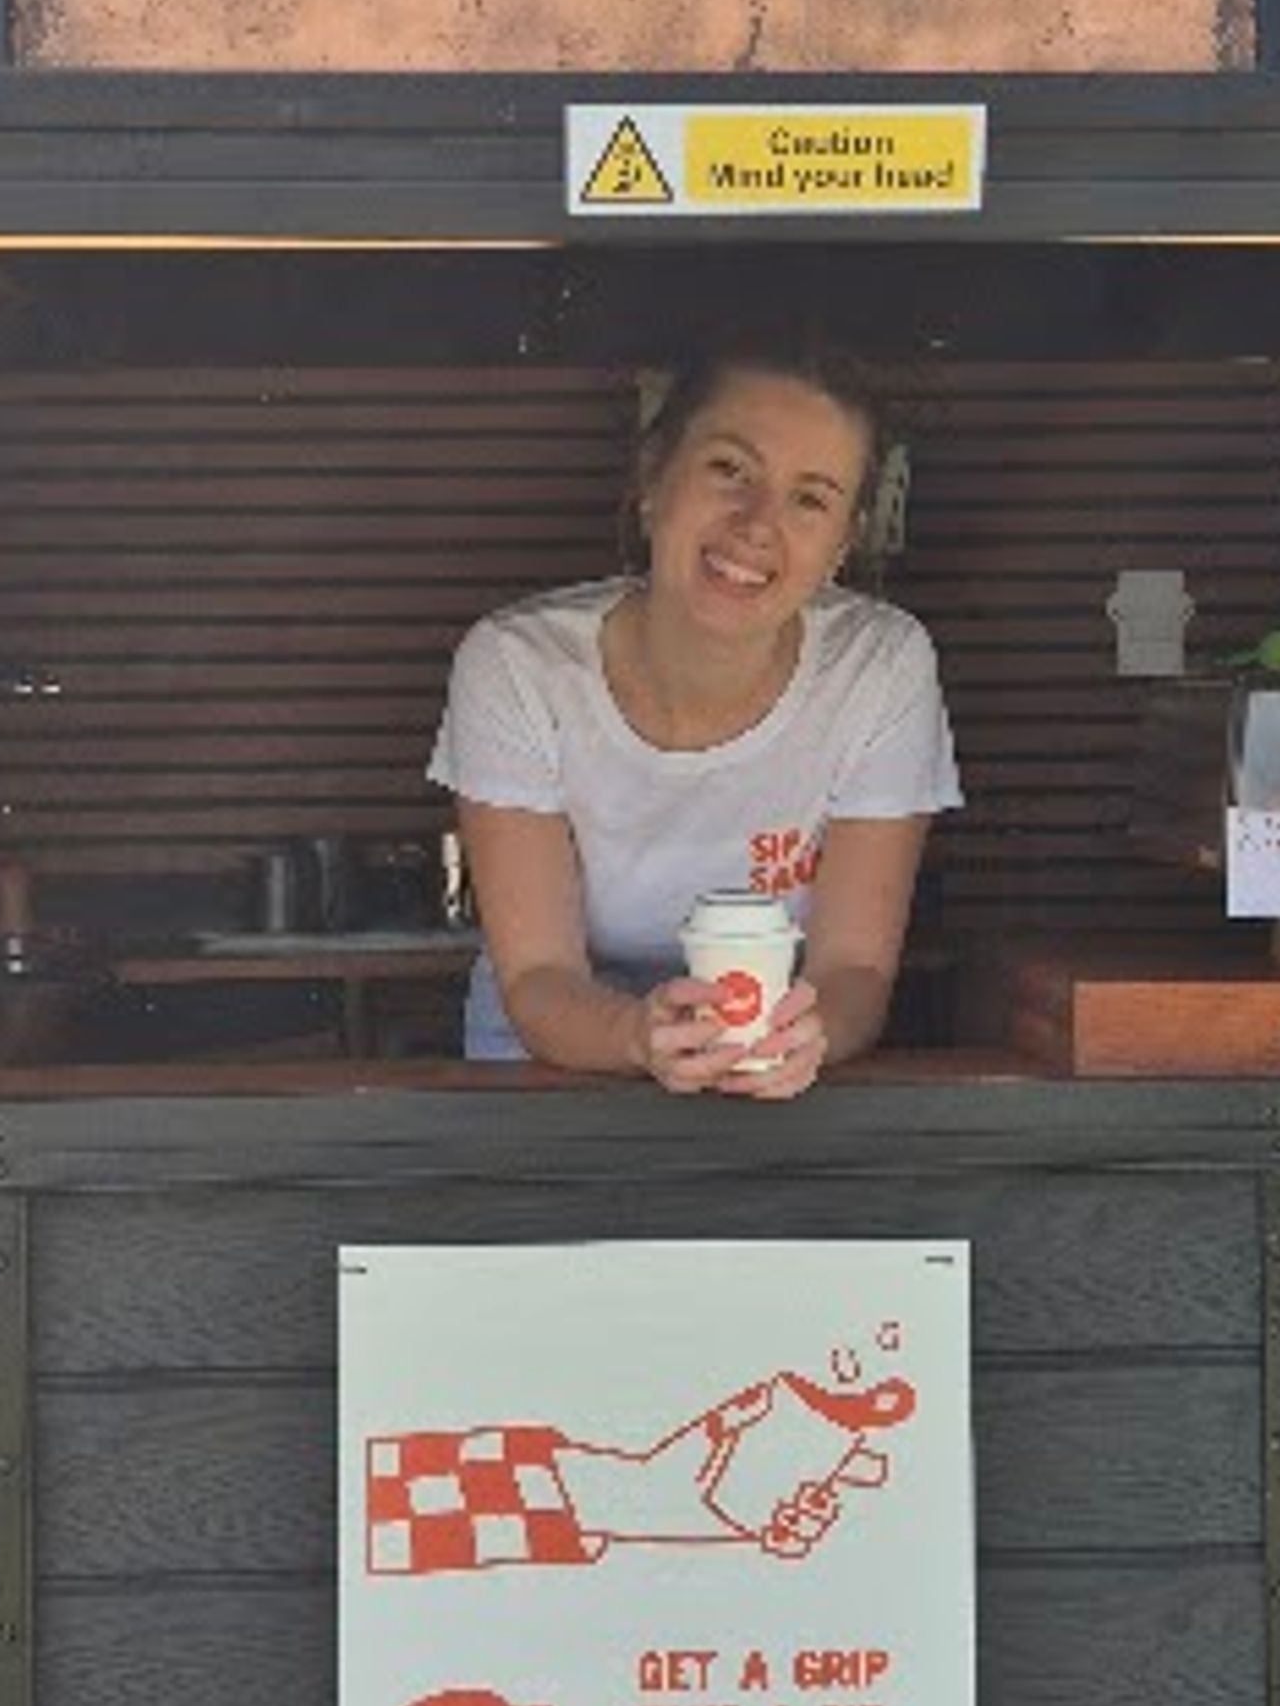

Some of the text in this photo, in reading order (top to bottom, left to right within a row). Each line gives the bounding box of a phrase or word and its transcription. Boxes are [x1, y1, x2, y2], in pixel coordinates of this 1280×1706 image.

[768, 126, 896, 156] Caution
[708, 160, 955, 194] Mind your head
[637, 1651, 890, 1693] GET A GRIP
